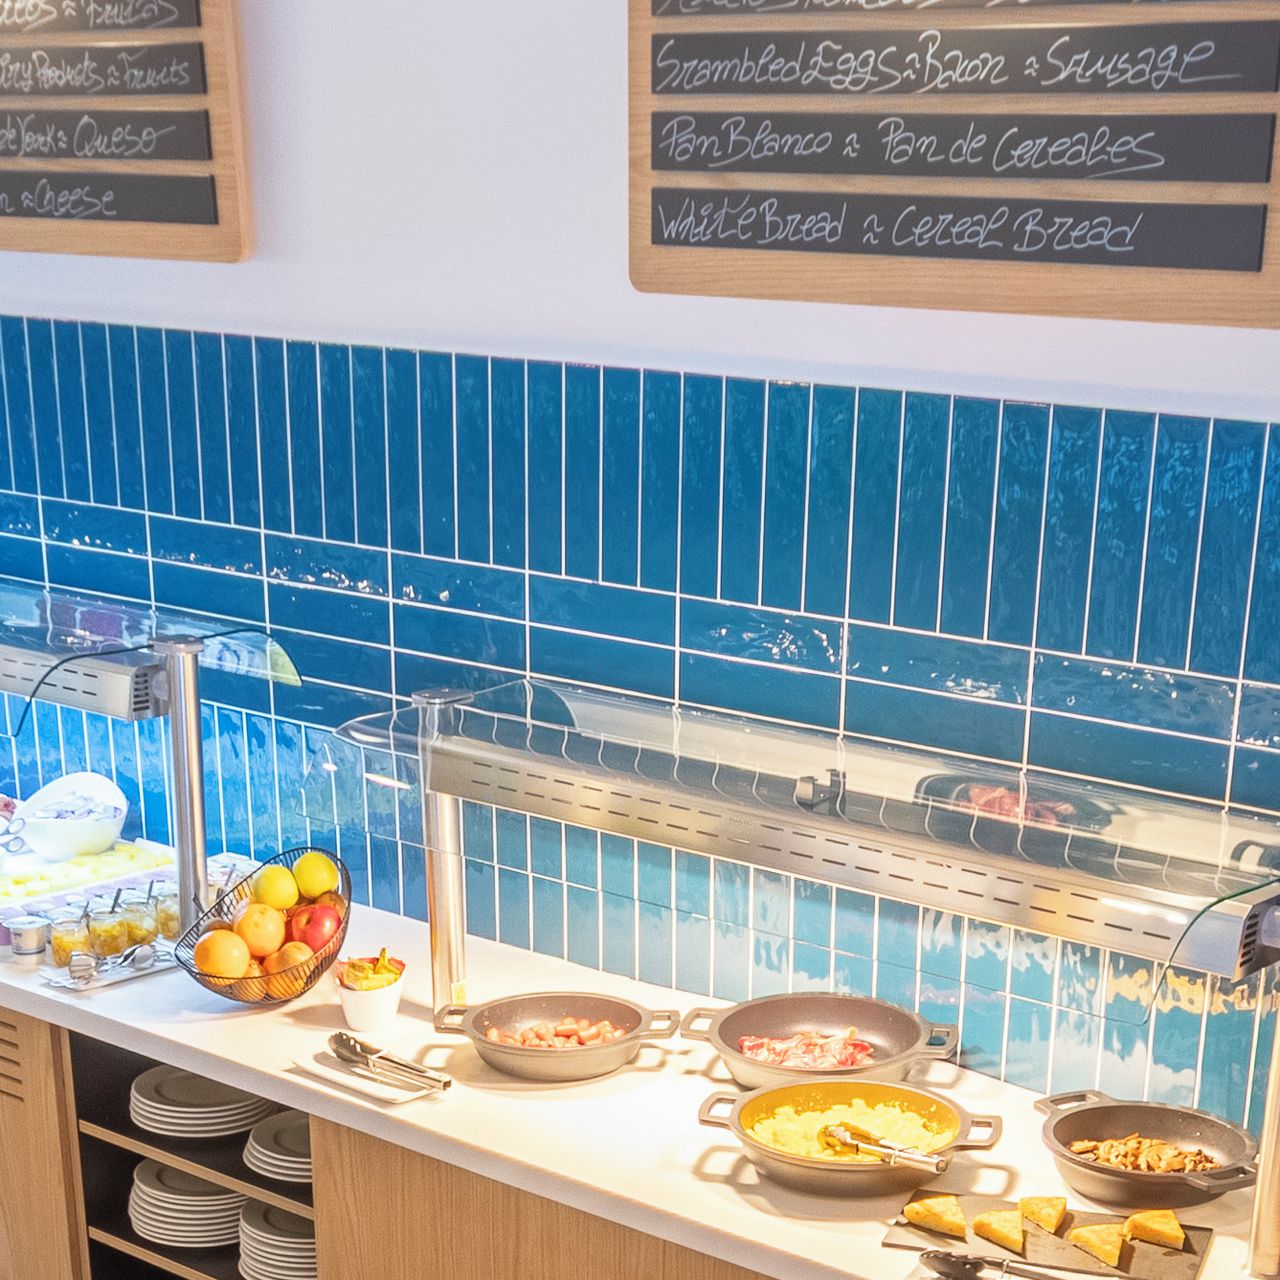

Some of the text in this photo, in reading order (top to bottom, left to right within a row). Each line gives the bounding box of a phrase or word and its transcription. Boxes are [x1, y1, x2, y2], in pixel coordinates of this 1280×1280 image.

[117, 48, 190, 90] Fruits
[801, 40, 901, 94] Eggs
[909, 29, 1009, 95] Bacon
[73, 114, 177, 157] Queso
[659, 115, 1165, 180] Pan Blanco Pan de Cereales
[34, 177, 118, 219] Cheese
[658, 194, 1144, 252] White Bread Cereal Bread
